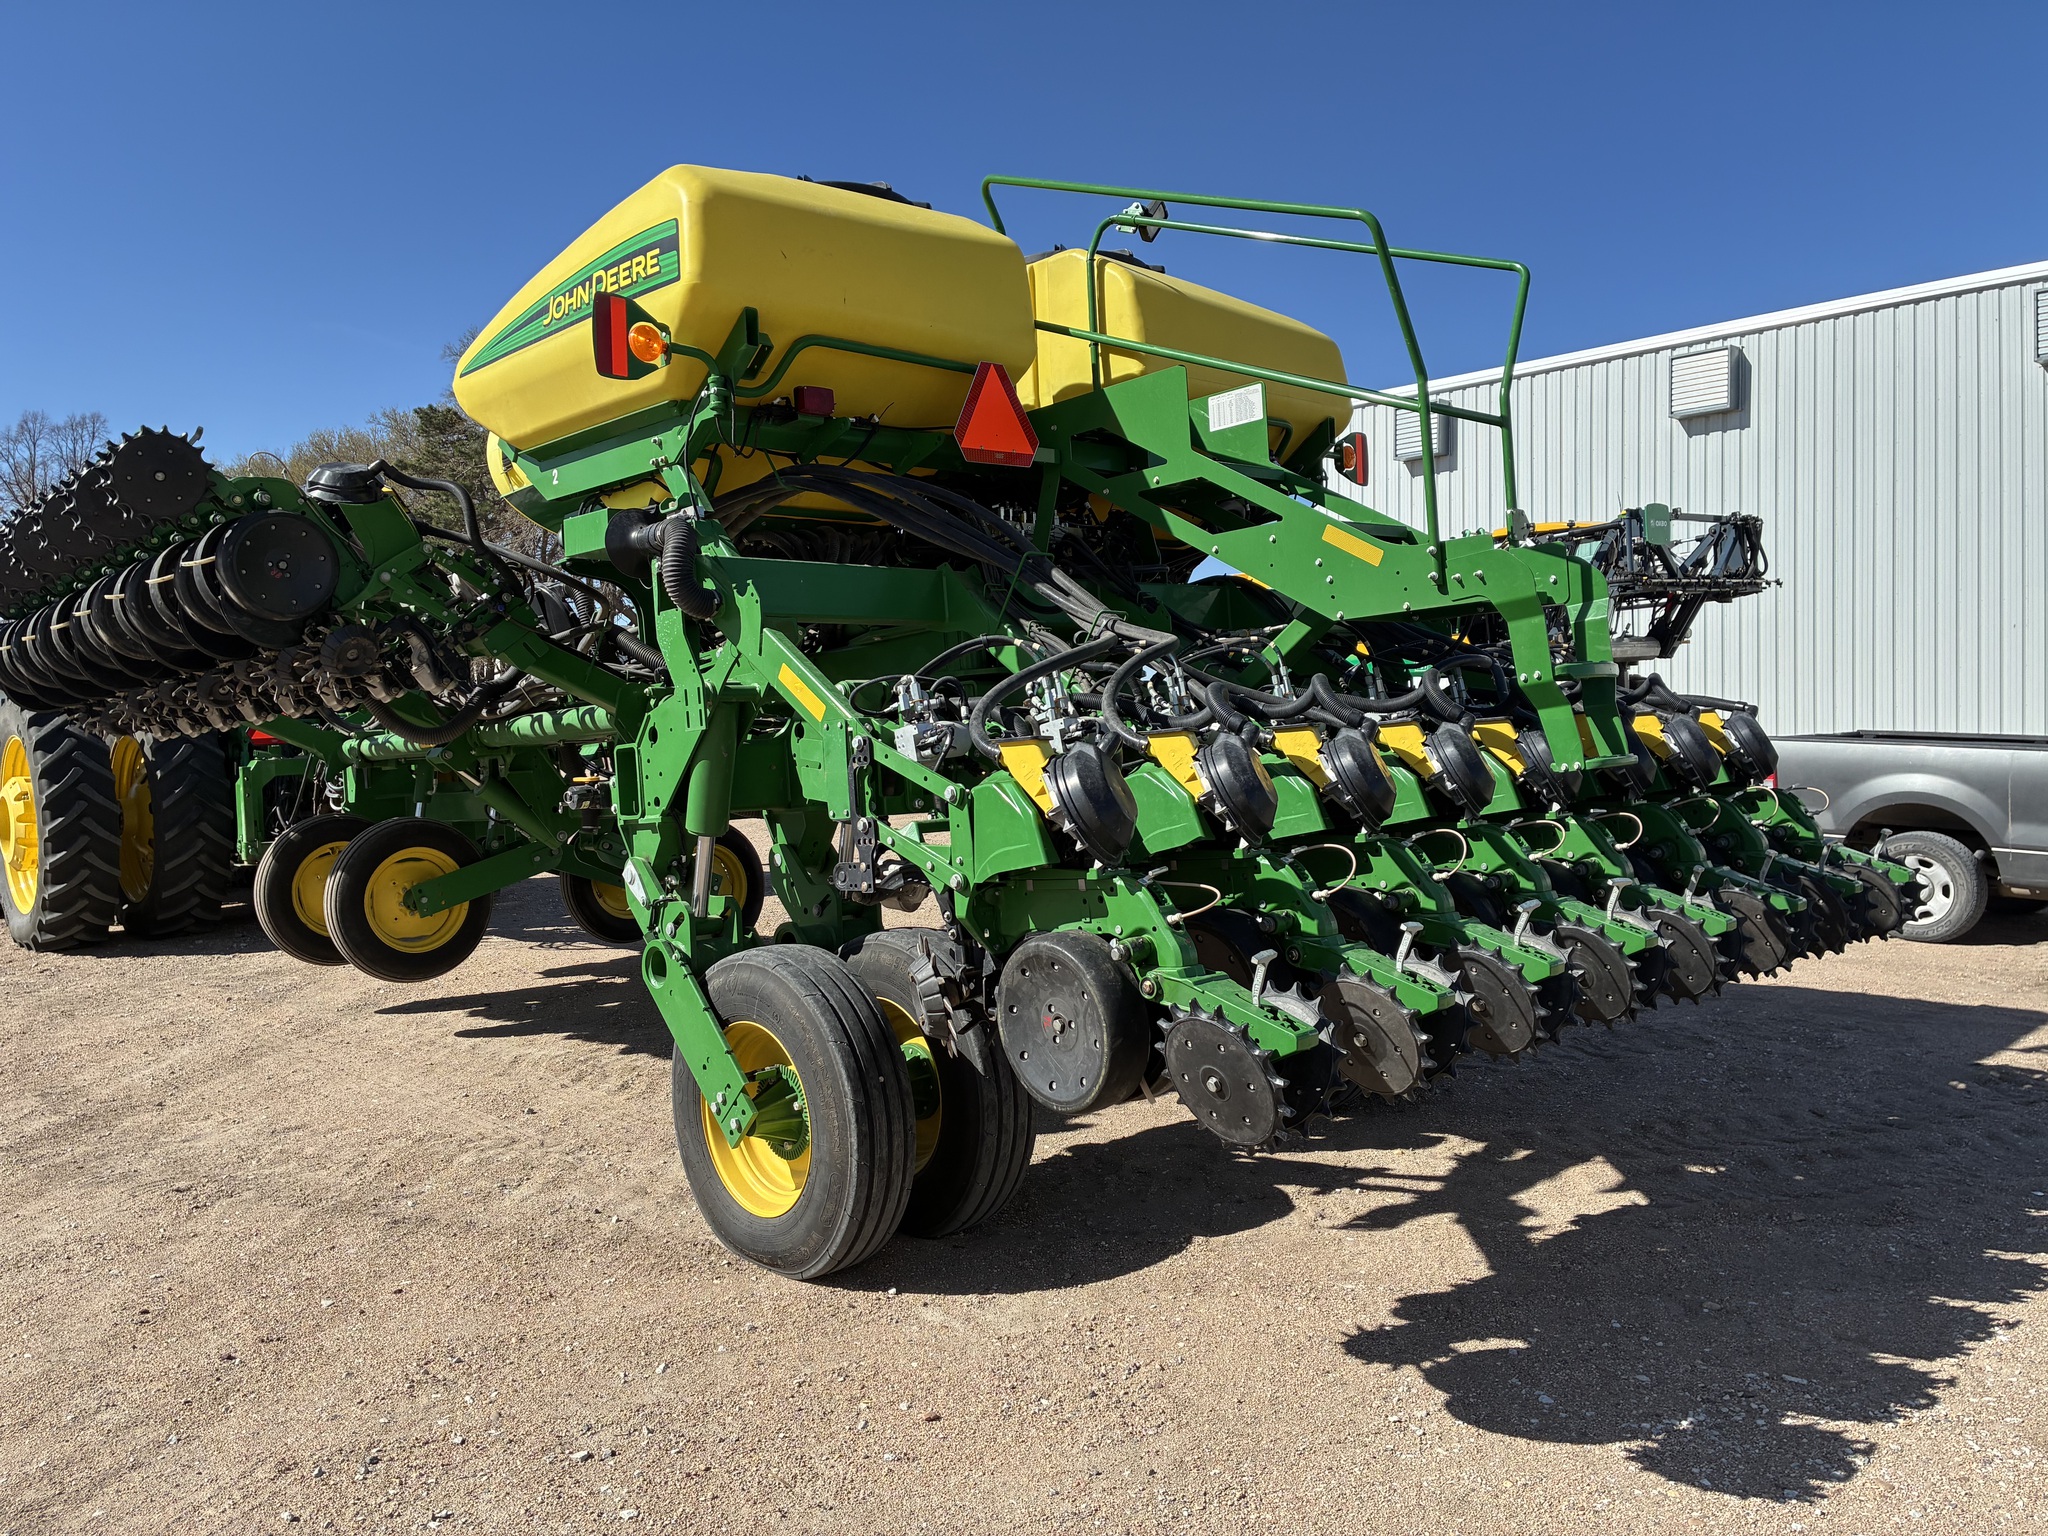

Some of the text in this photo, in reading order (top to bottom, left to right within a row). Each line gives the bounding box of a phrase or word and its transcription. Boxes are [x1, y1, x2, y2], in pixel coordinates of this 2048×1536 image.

[543, 248, 660, 327] JOHN DEERE
[552, 469, 559, 485] 2
